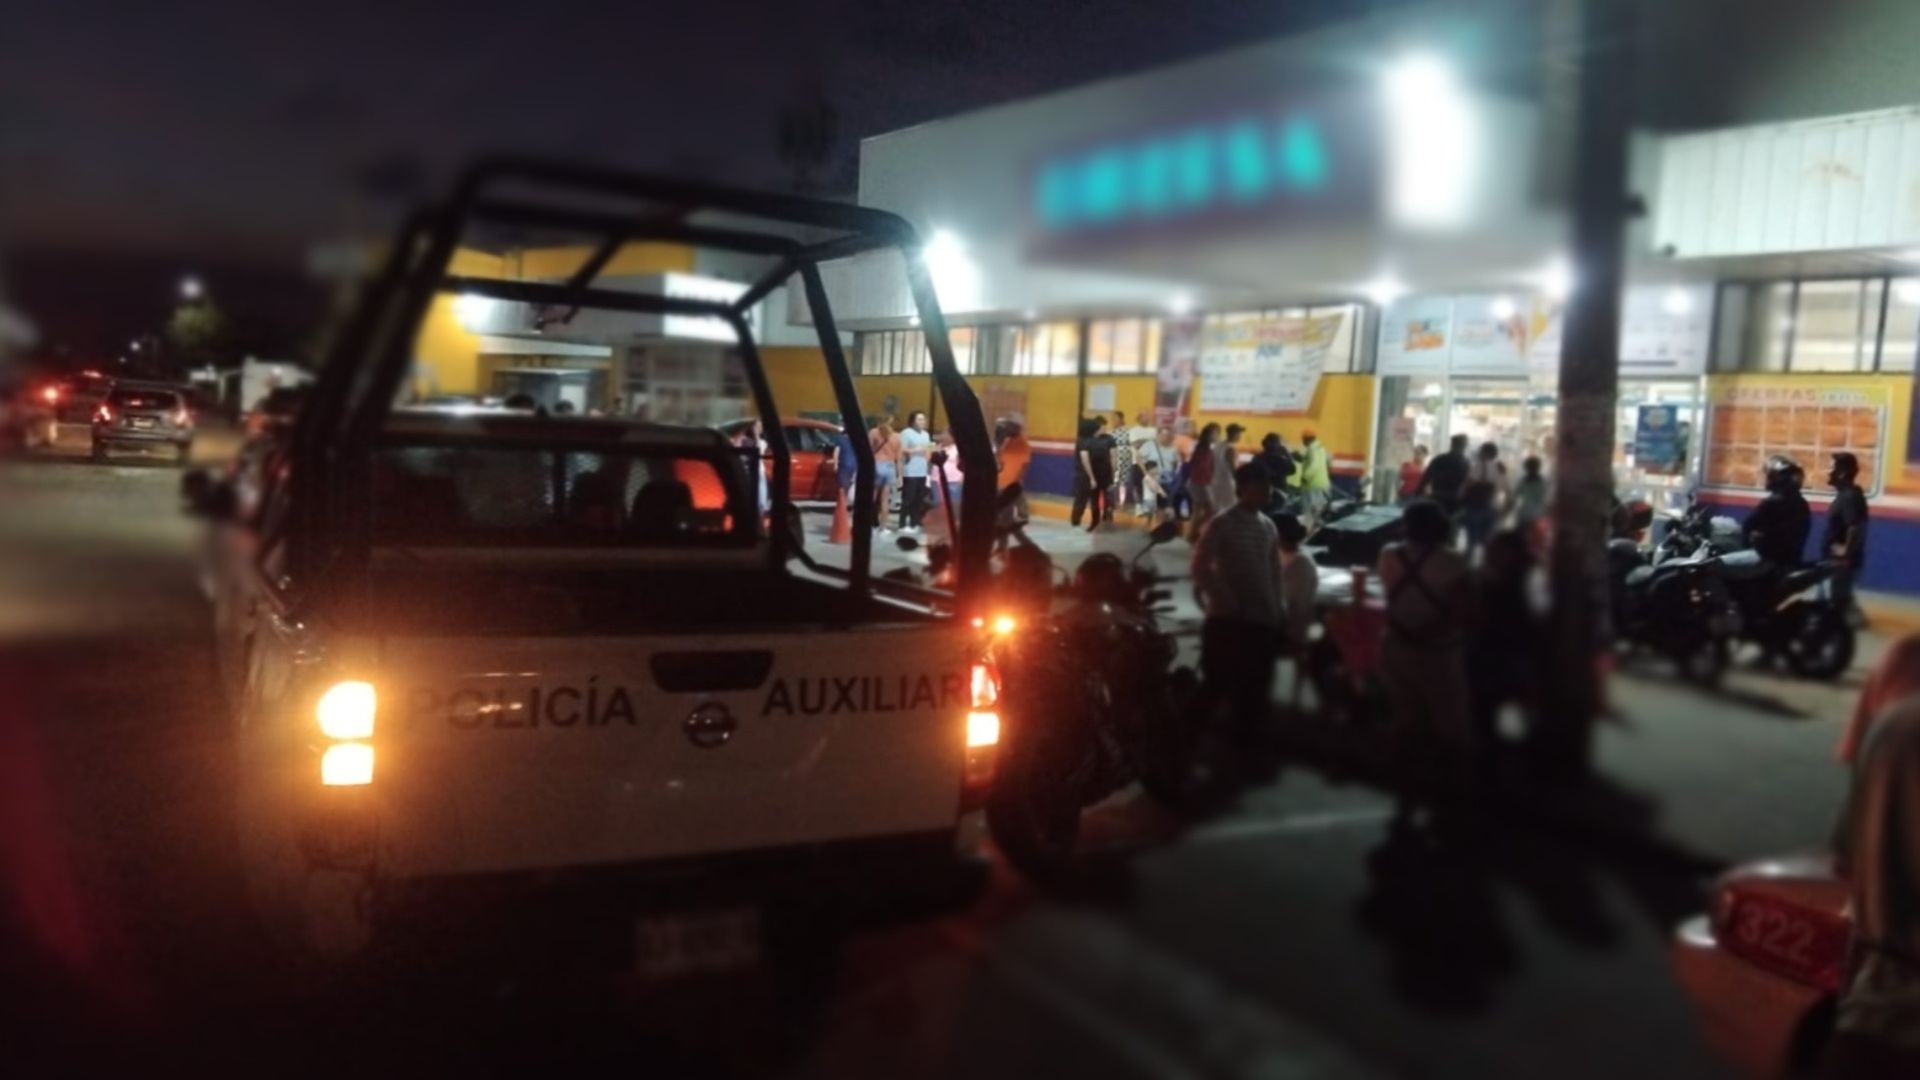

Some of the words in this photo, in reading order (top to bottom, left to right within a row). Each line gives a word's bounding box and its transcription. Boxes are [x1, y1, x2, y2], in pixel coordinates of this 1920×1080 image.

[415, 675, 637, 729] POLICÍA
[761, 673, 964, 717] AUXILIAR
[1738, 902, 1815, 967] 322
